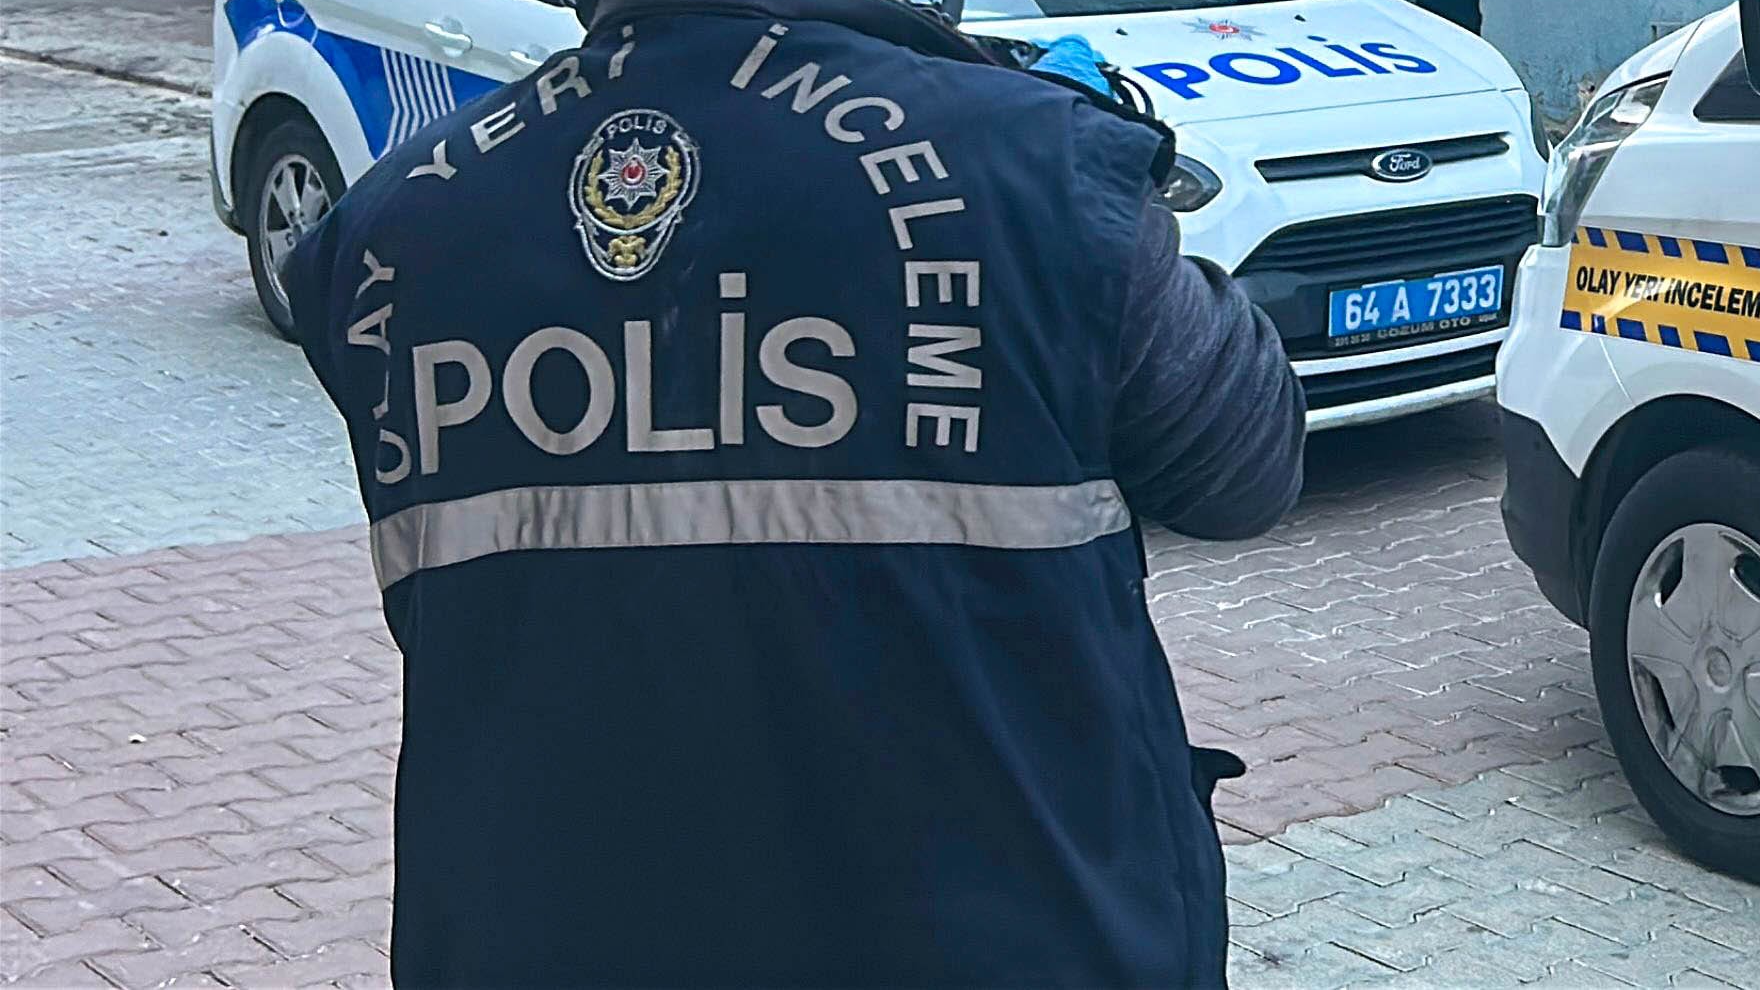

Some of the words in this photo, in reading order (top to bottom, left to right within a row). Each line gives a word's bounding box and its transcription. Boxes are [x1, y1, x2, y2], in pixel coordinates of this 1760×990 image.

[1132, 35, 1438, 100] POLİS
[1389, 153, 1421, 172] Ford
[1345, 290, 1380, 330] 64
[1391, 286, 1411, 322] A
[1427, 274, 1496, 317] 7333
[1576, 266, 1621, 296] OLAY
[1439, 316, 1471, 330] OTO
[412, 272, 858, 475] POLİS
